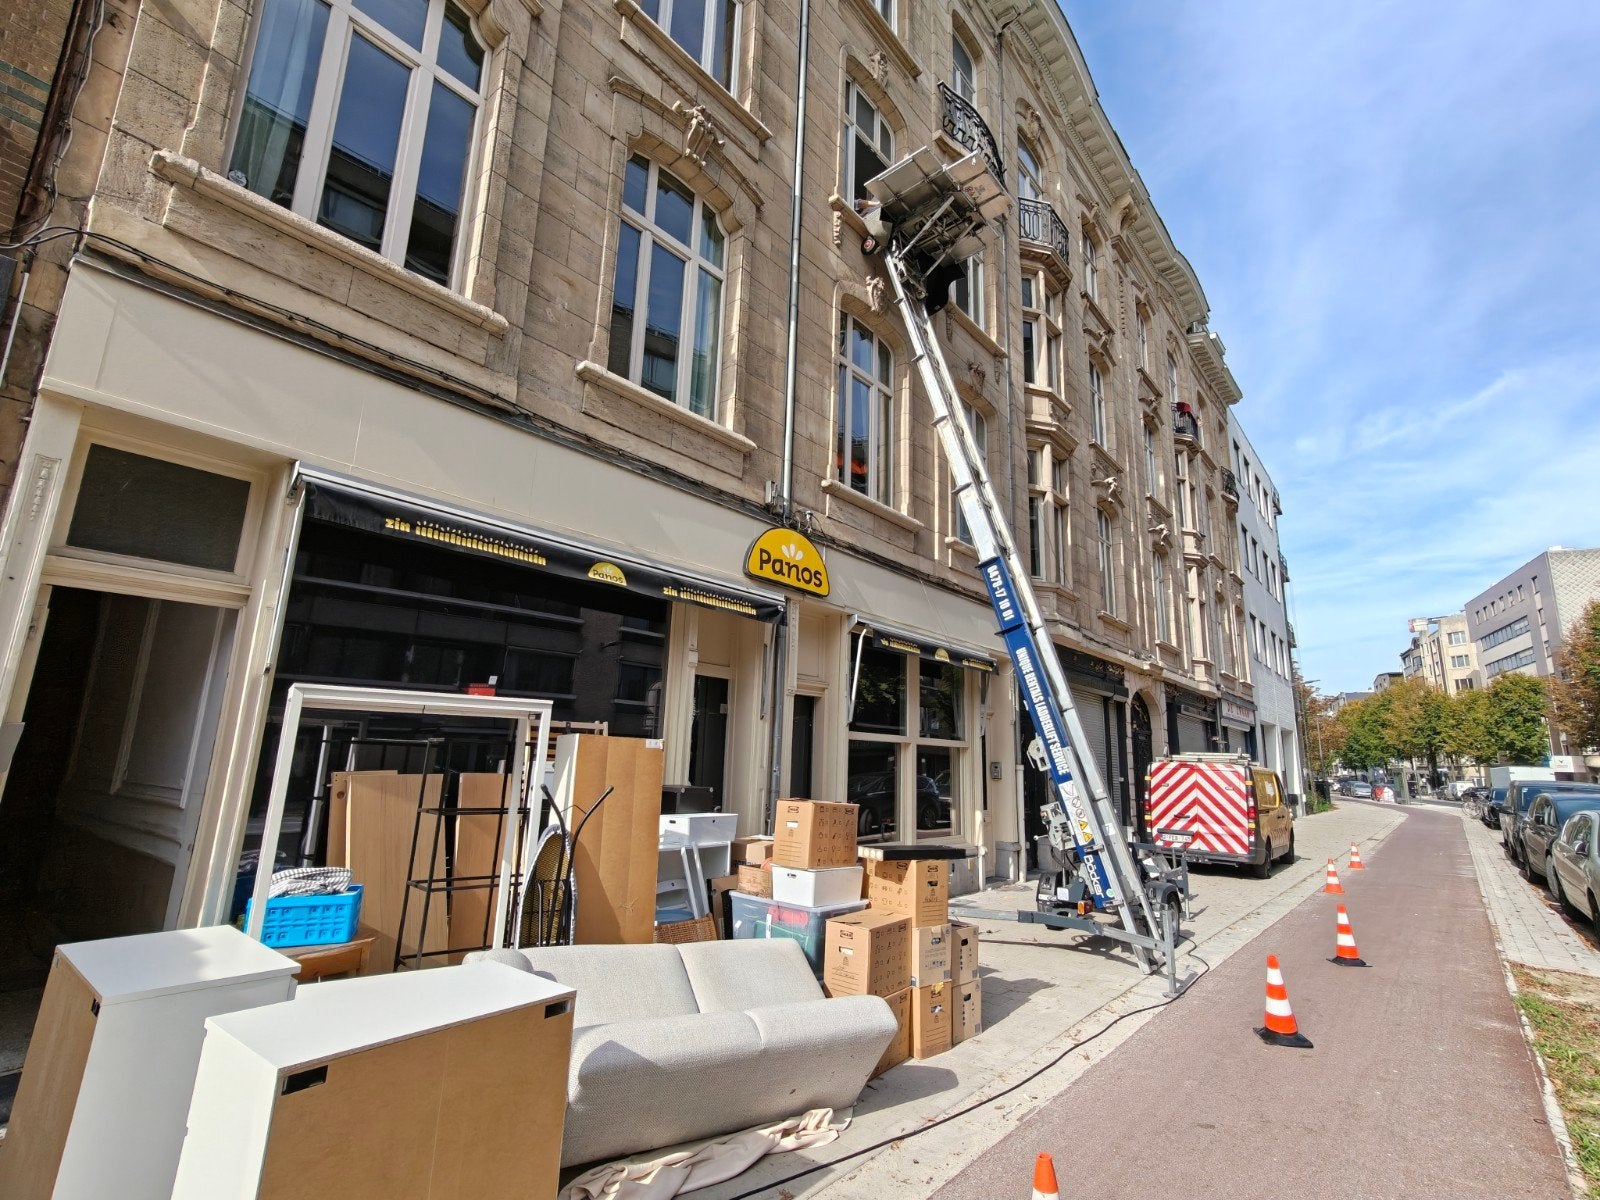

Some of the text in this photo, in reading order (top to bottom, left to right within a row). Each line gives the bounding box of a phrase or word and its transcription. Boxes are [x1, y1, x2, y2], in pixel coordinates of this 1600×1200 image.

[385, 517, 411, 533] zin
[592, 569, 624, 584] Panos
[759, 547, 823, 588] Panos
[663, 586, 678, 597] zin
[1015, 646, 1070, 776] UNIQUE RENTALS LADDERLIFT SERVICE
[1083, 854, 1105, 899] Böcker
